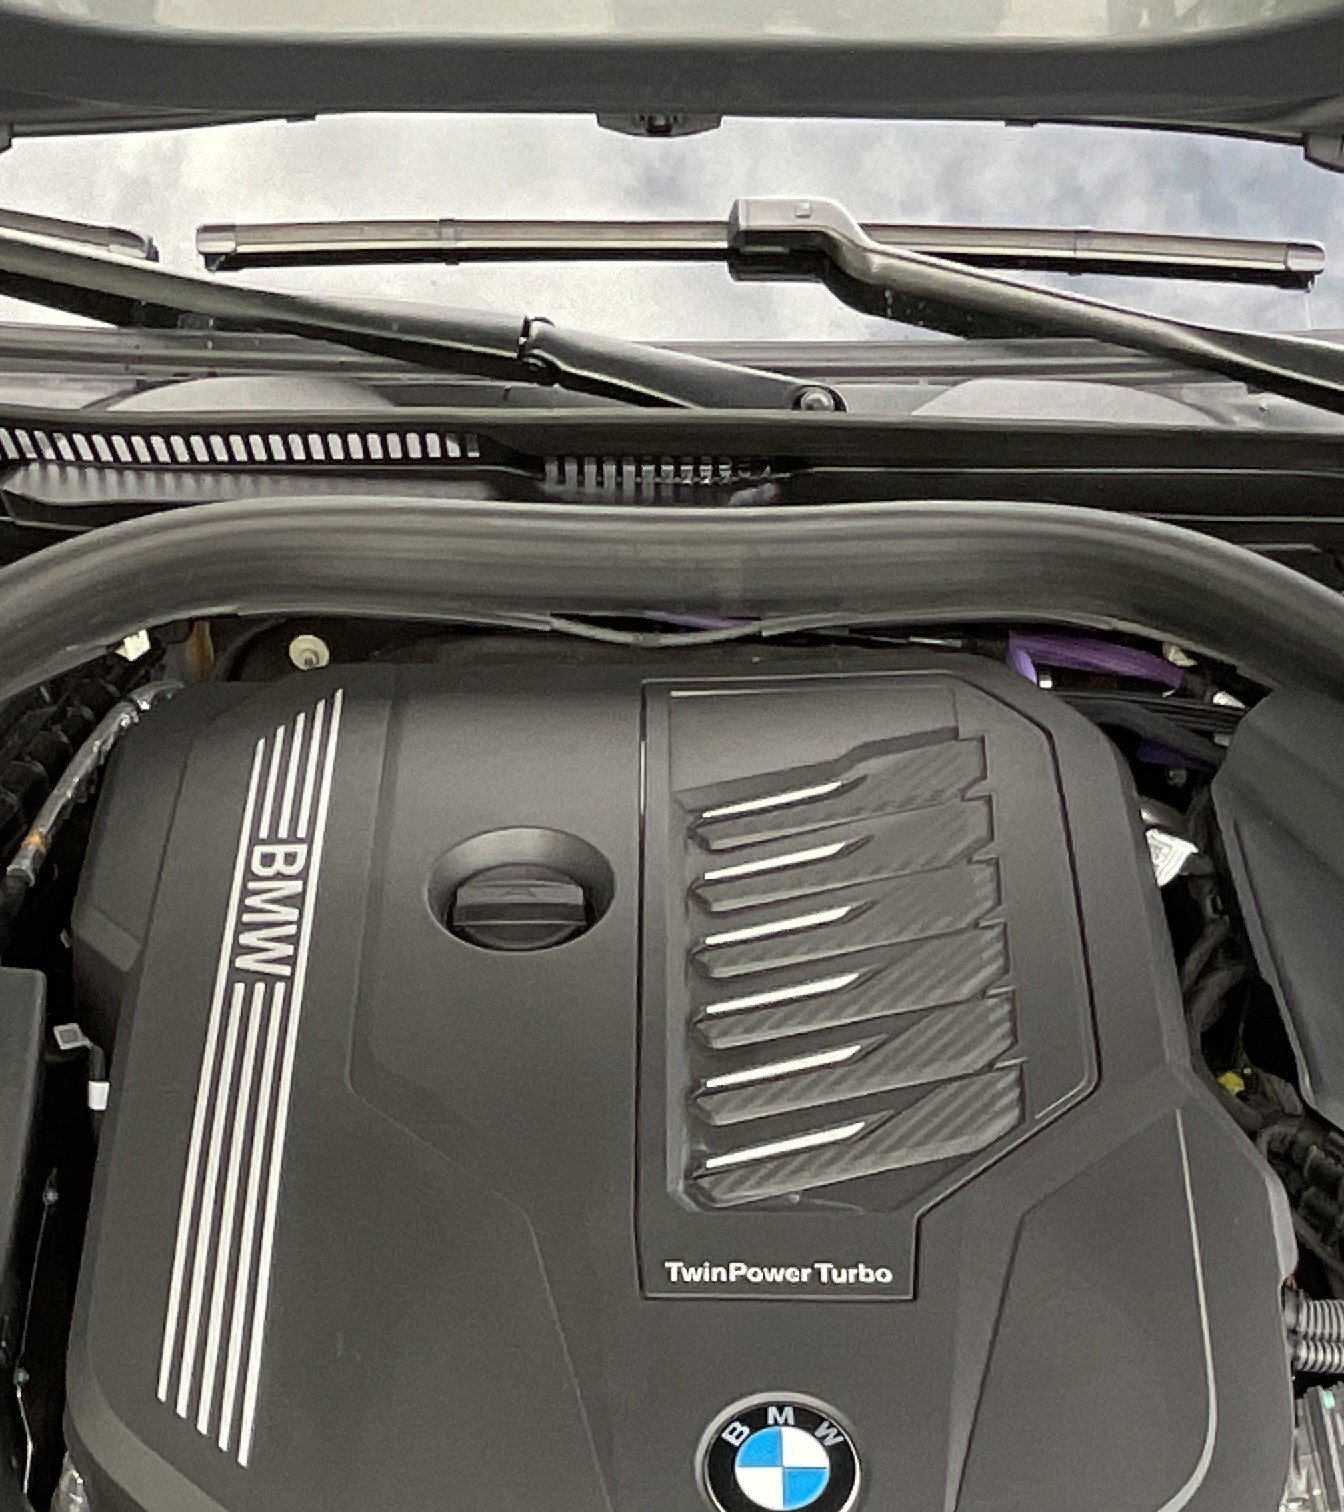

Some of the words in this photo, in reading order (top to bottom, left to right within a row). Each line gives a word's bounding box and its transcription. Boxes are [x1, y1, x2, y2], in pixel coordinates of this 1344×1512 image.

[234, 842, 308, 977] BMW
[664, 1260, 812, 1283] TwinPower
[813, 1261, 894, 1284] Turbo
[720, 1405, 845, 1448] BMW
